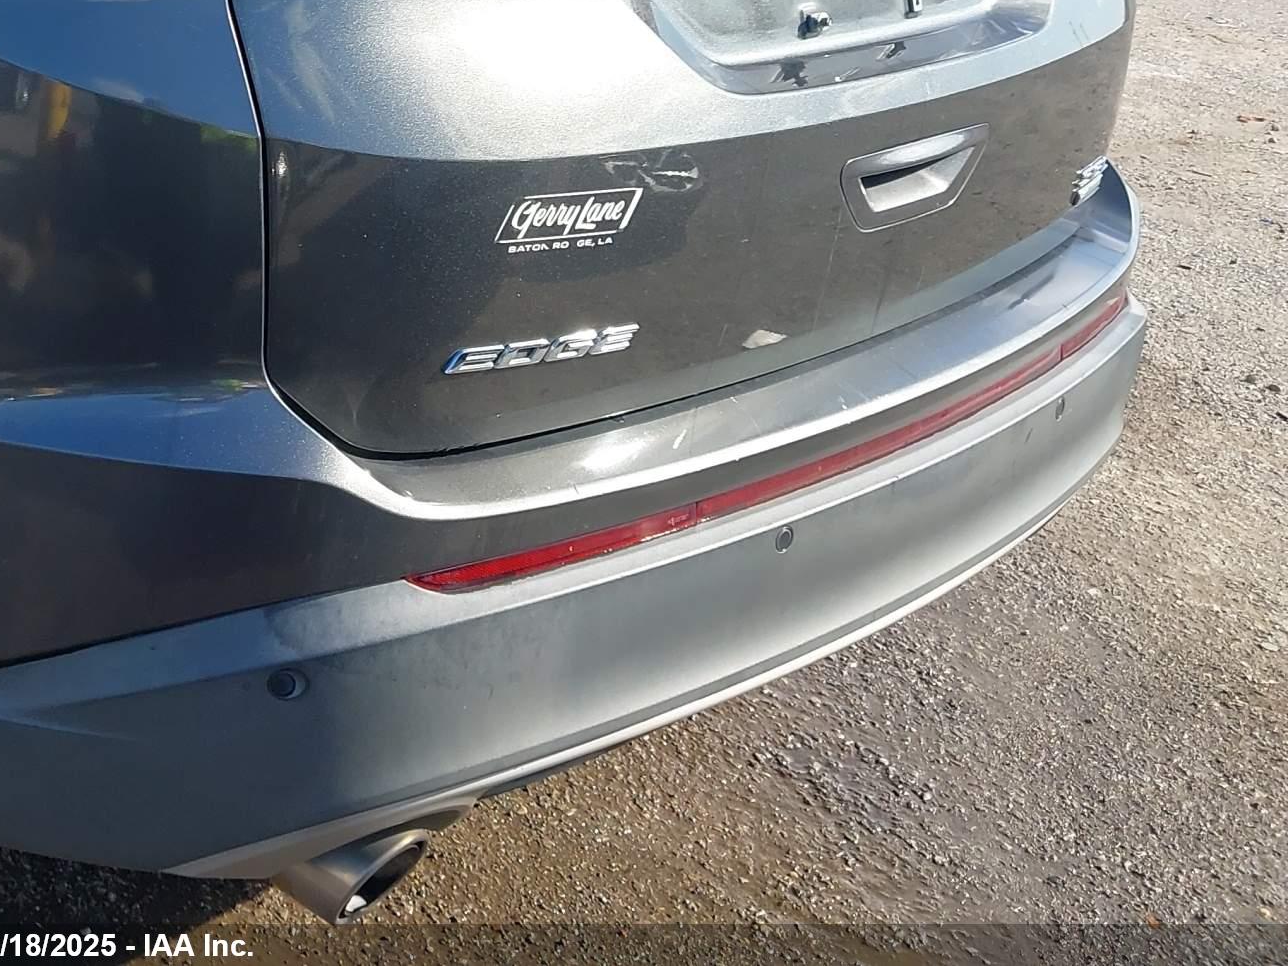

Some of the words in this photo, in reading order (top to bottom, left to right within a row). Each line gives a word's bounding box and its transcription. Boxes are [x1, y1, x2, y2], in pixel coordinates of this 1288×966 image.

[511, 200, 581, 239] Gerry
[575, 196, 626, 230] Lane
[597, 236, 613, 246] LA
[442, 321, 641, 375] EDGE
